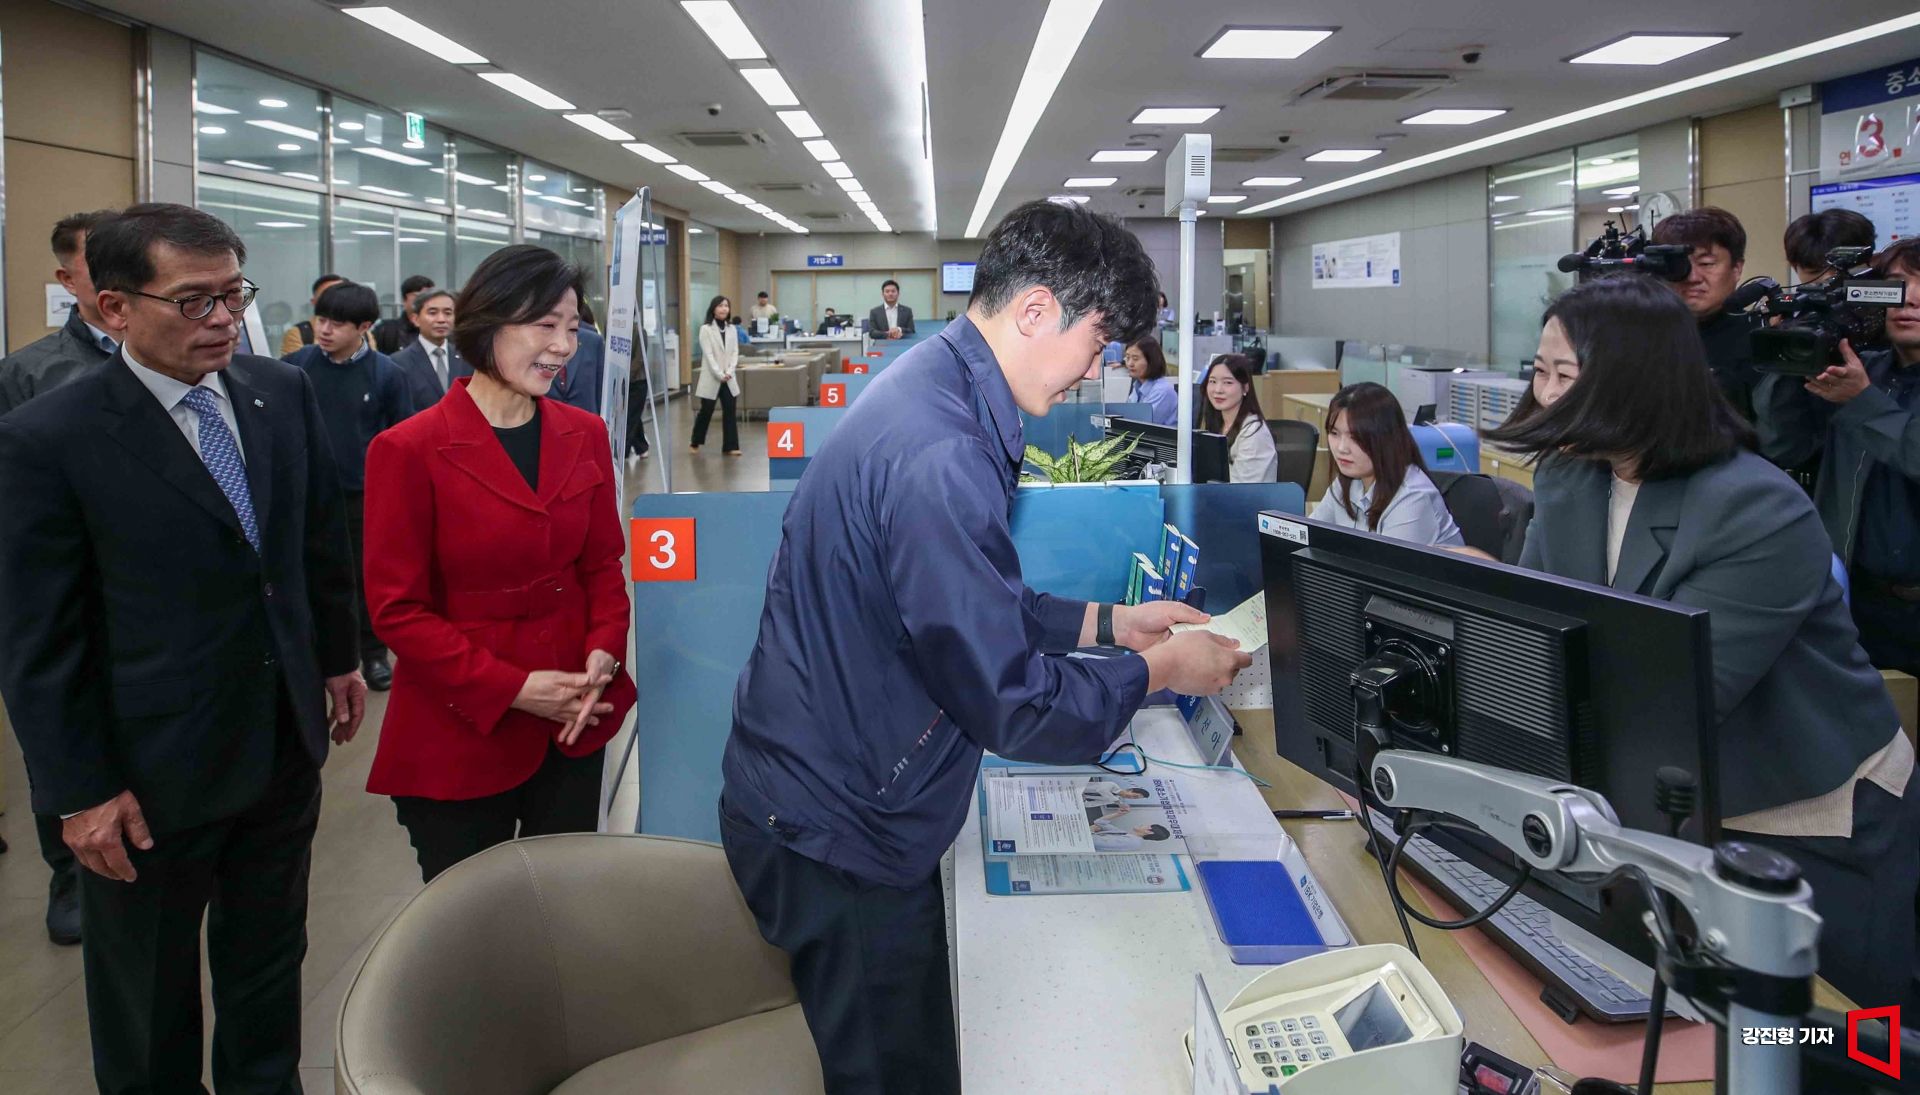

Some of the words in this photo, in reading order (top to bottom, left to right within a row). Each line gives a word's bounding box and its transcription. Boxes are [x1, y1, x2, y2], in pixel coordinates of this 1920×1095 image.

[827, 387, 839, 404] 5
[777, 428, 794, 452] 4
[649, 529, 677, 570] 3
